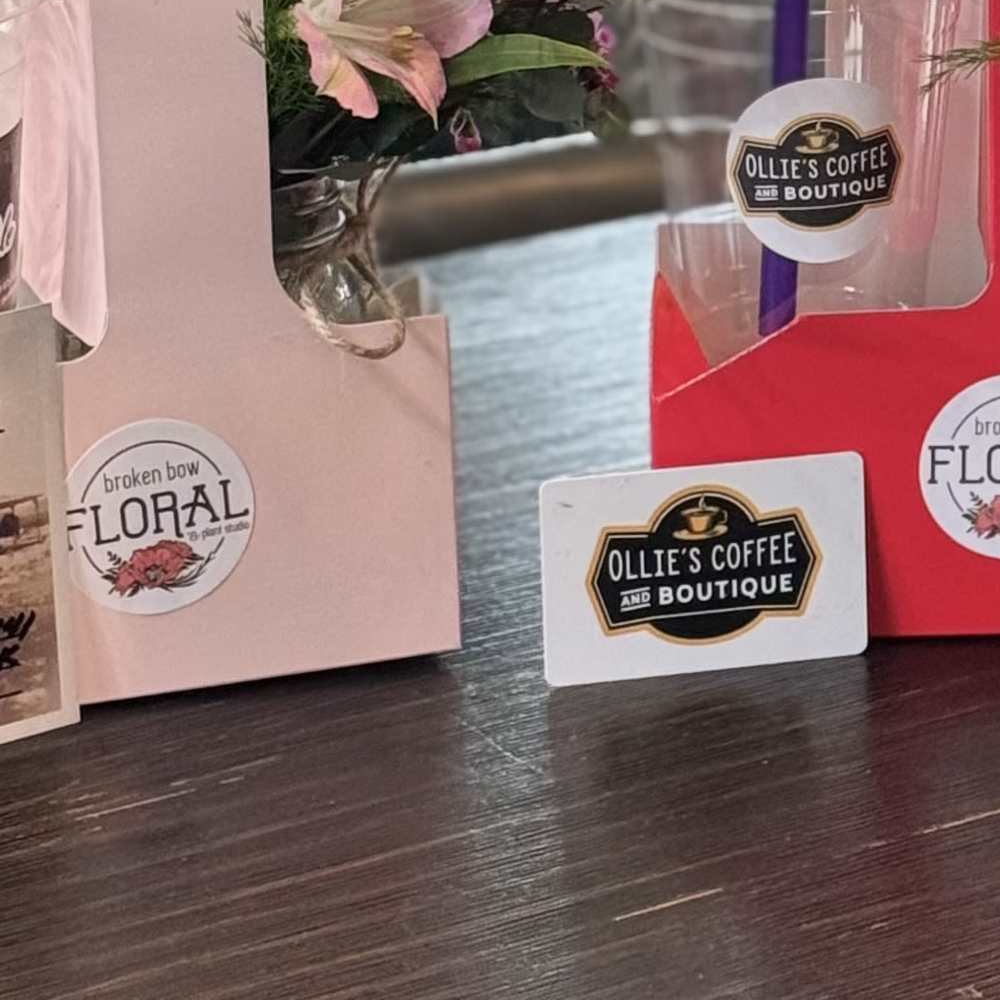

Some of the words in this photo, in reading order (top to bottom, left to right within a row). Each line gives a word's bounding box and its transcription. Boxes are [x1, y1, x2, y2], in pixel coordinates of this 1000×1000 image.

[745, 153, 819, 179] OLLIE'S
[826, 143, 888, 177] COFFEE
[754, 188, 778, 198] AND
[784, 175, 886, 200] BOUTIQUE
[103, 467, 162, 493] broken
[166, 460, 200, 481] bow
[66, 479, 249, 551] FLORAL
[608, 547, 701, 582] OLLIE'S
[711, 531, 797, 571] COFFEE
[620, 591, 651, 608] AND
[658, 573, 793, 606] BOUTIQUE
